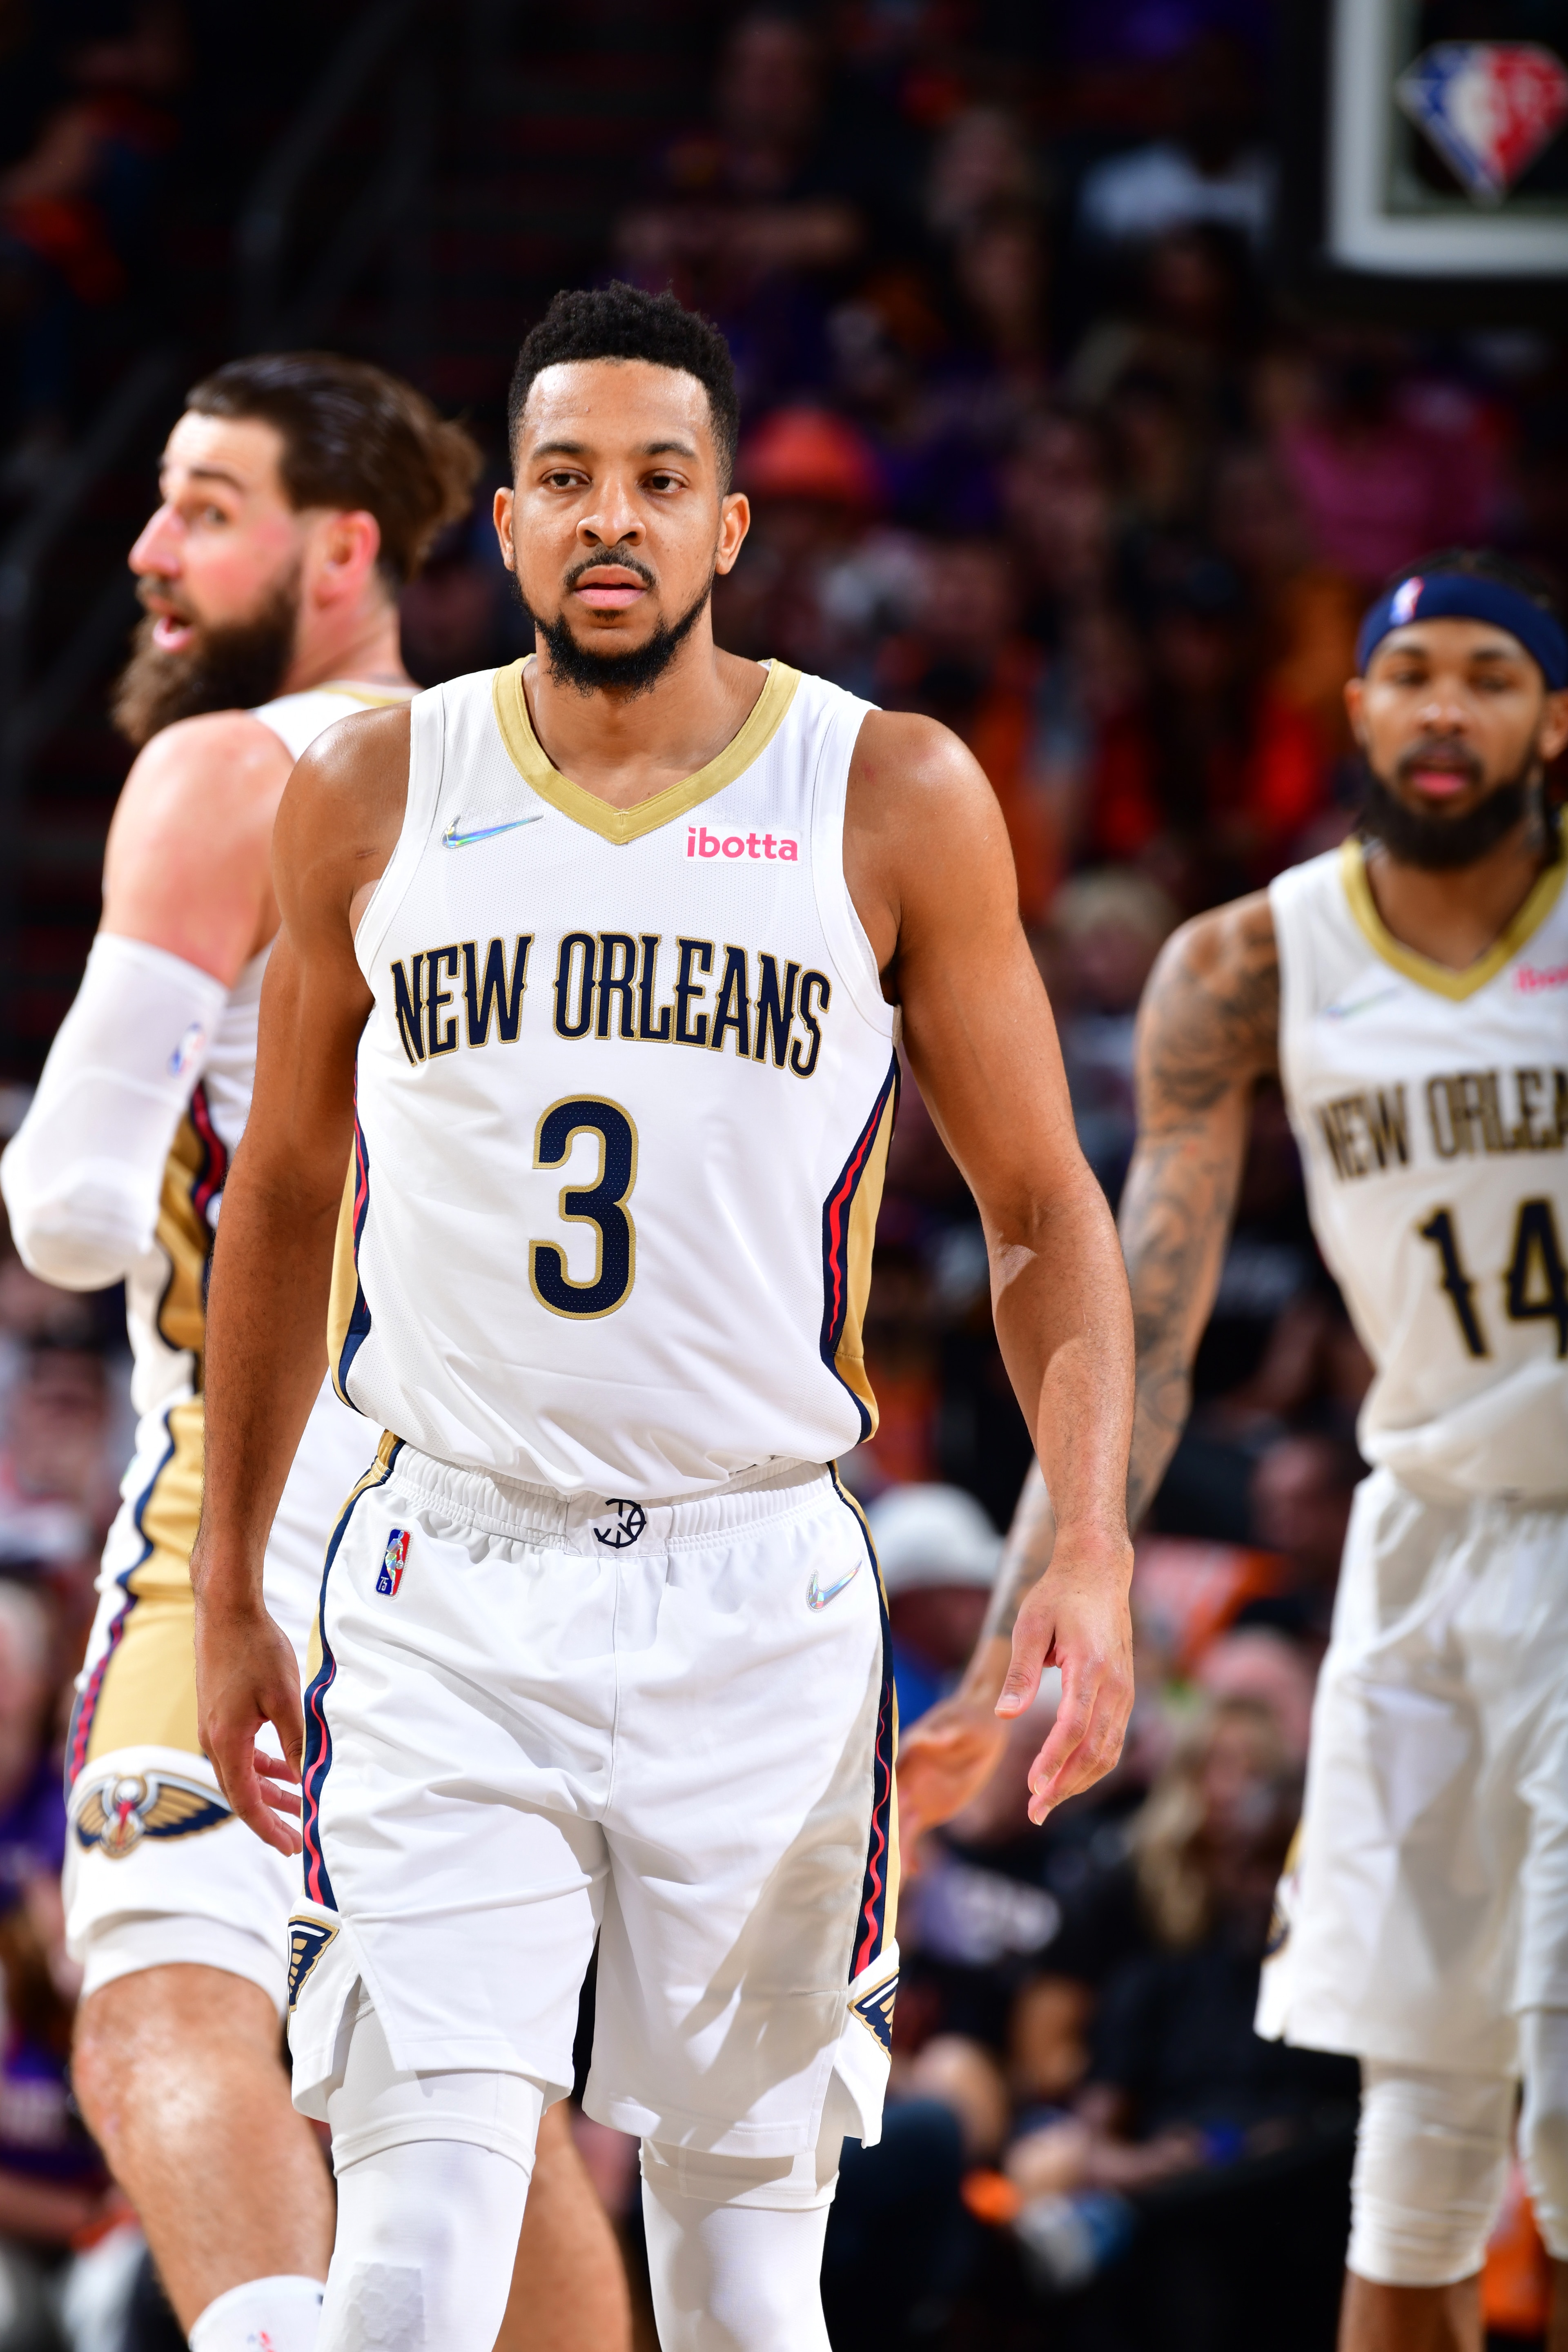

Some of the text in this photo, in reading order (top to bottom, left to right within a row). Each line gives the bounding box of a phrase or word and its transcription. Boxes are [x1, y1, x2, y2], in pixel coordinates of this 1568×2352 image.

[687, 826, 798, 861] ibotta
[390, 931, 832, 1079] NEW ORLEANS
[1315, 1081, 1409, 1182] NEW
[529, 1094, 639, 1320] 3
[1415, 1197, 1568, 1361] 14
[378, 1576, 389, 1591] 75
